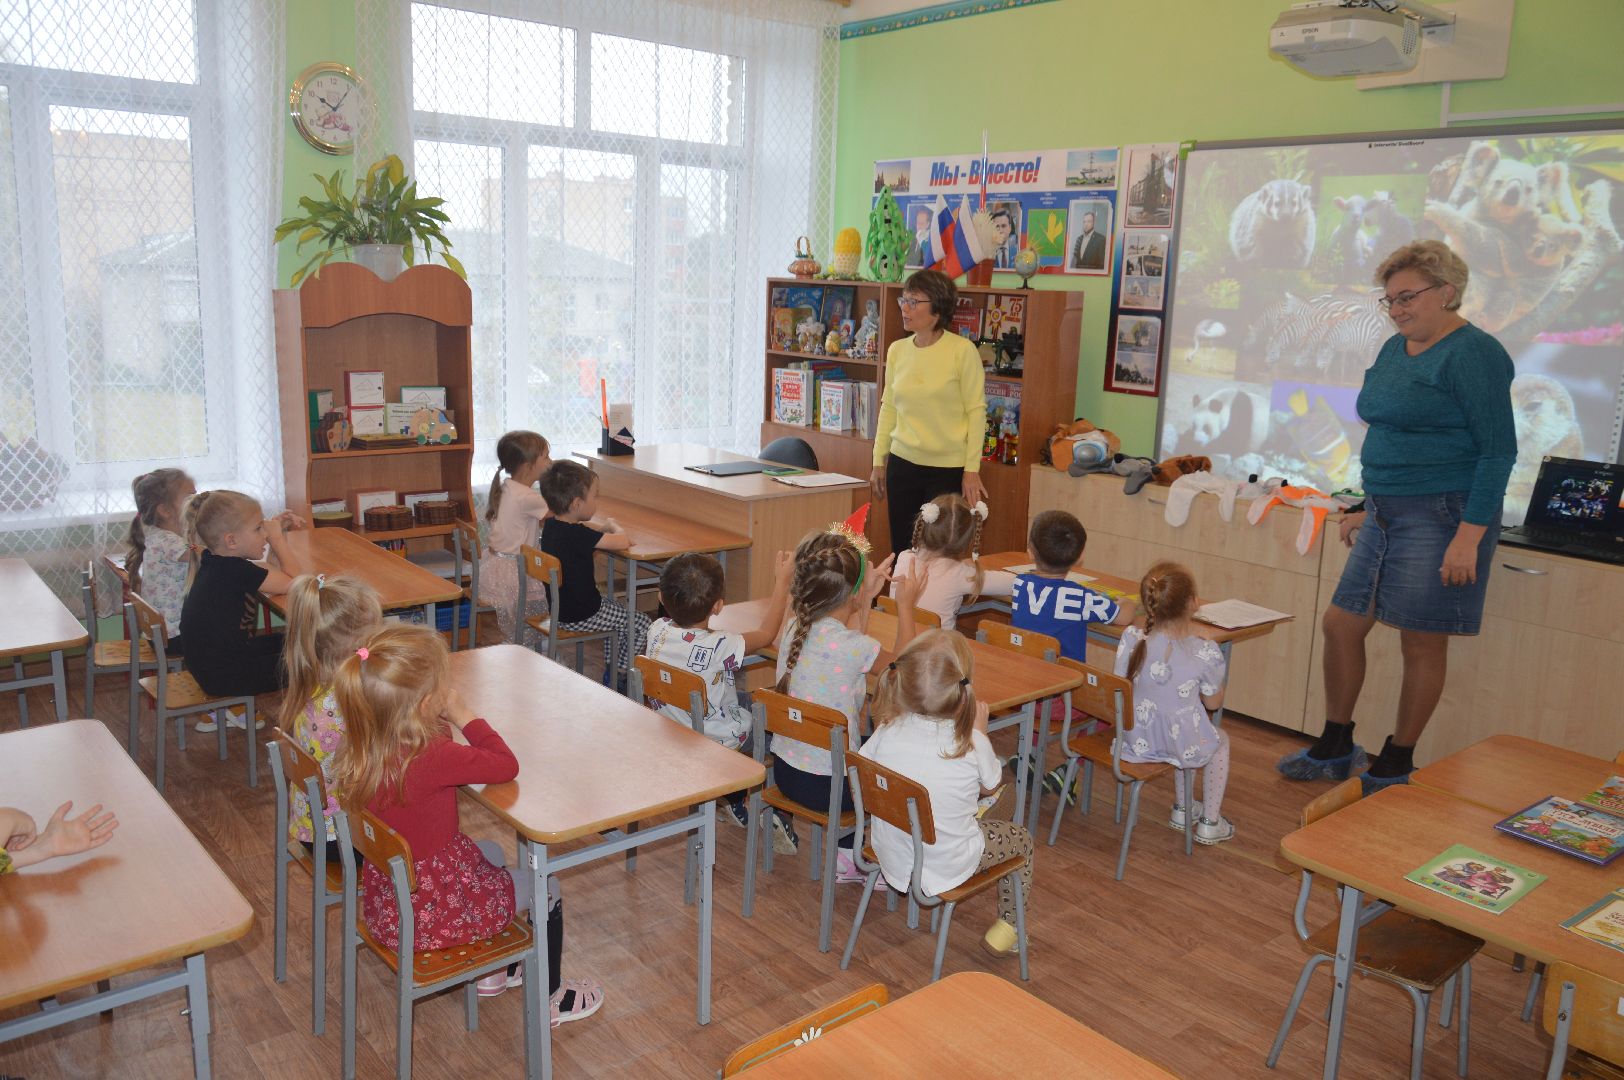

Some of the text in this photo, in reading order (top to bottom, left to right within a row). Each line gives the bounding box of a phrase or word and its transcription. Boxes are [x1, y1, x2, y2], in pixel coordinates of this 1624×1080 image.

[330, 77, 337, 85] 12
[930, 161, 960, 187] Мы
[1009, 297, 1023, 313] 75
[985, 387, 1005, 396] ОССИИ
[792, 711, 798, 720] 2
